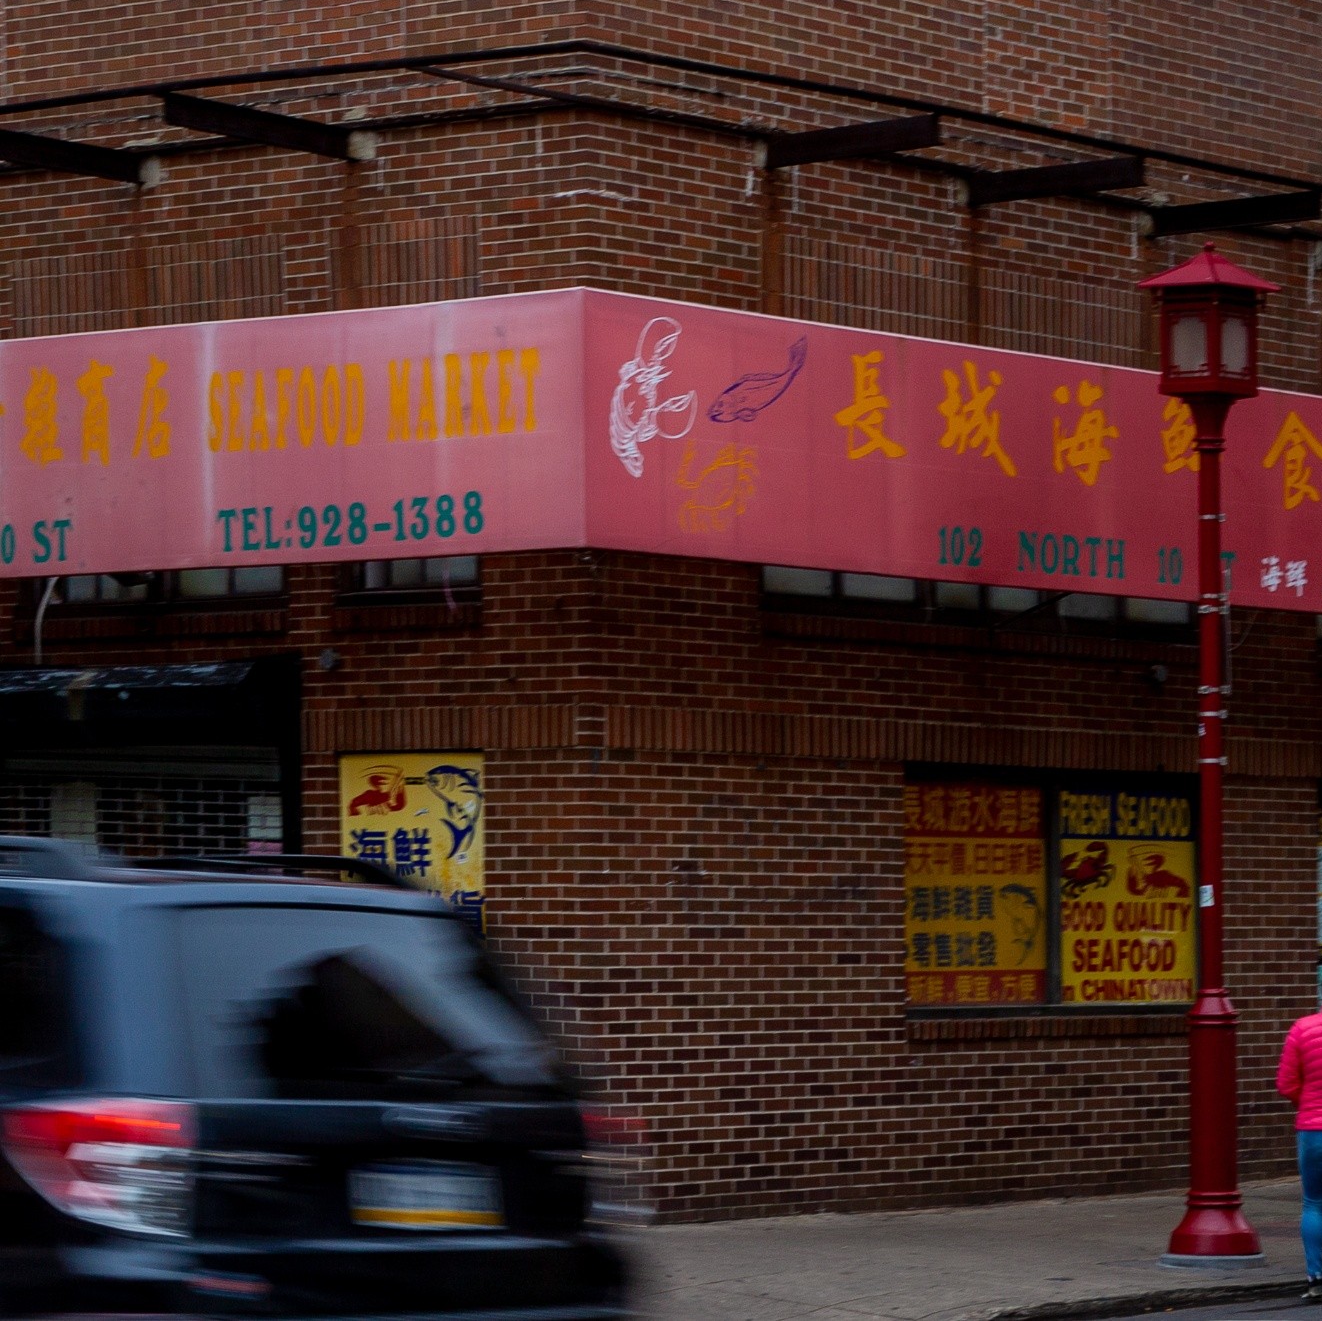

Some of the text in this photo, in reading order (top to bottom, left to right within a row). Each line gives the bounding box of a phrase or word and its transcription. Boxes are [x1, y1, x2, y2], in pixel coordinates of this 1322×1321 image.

[0, 353, 172, 468] 雜商店
[208, 347, 541, 454] SEAFOOD MARKET
[33, 519, 73, 564] ST
[218, 490, 487, 554] TEL:928-1388
[938, 526, 983, 568] 102
[1017, 531, 1127, 580] NORTH
[1156, 546, 1184, 586] 10
[1059, 790, 1191, 837] FRESH SEAFOOD
[350, 828, 432, 877] 海鮮
[1060, 900, 1193, 934] GOOD QUALITY
[1072, 938, 1176, 972] SEAFOOD
[1081, 978, 1193, 1002] CHINATOWN
